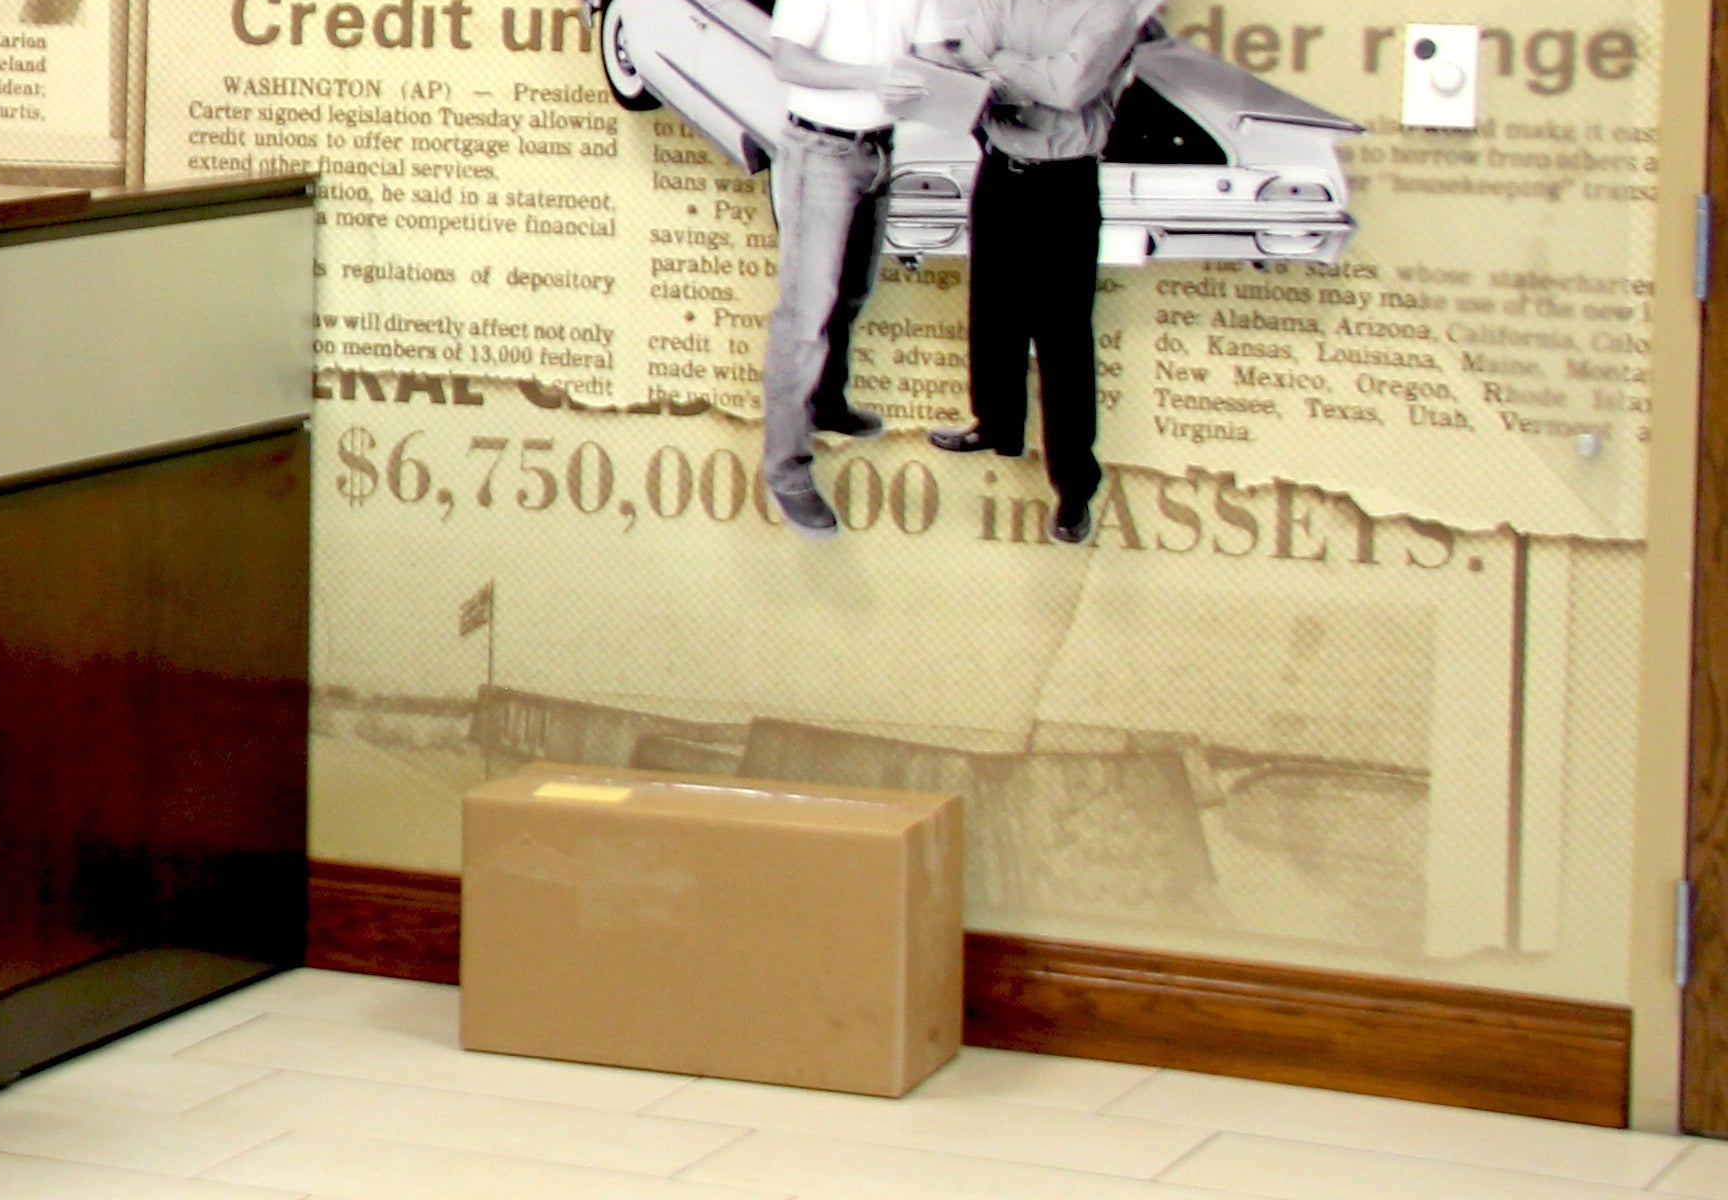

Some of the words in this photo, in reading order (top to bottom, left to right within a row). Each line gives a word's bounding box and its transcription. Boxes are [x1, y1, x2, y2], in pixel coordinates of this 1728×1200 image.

[1362, 25, 1639, 96] rnge
[222, 76, 382, 99] WASHINGTON
[188, 100, 252, 121] Carter
[328, 103, 432, 127] legislation
[438, 107, 523, 132] Tuesday
[352, 131, 404, 151] offer
[410, 134, 510, 158] mortgage
[395, 210, 517, 236] competitive
[525, 214, 616, 238] financial
[714, 200, 757, 225] Pay
[341, 261, 455, 282] regulations
[506, 266, 615, 294] depository
[1234, 281, 1312, 303] unions
[384, 313, 464, 337] directly
[1154, 359, 1210, 383] New
